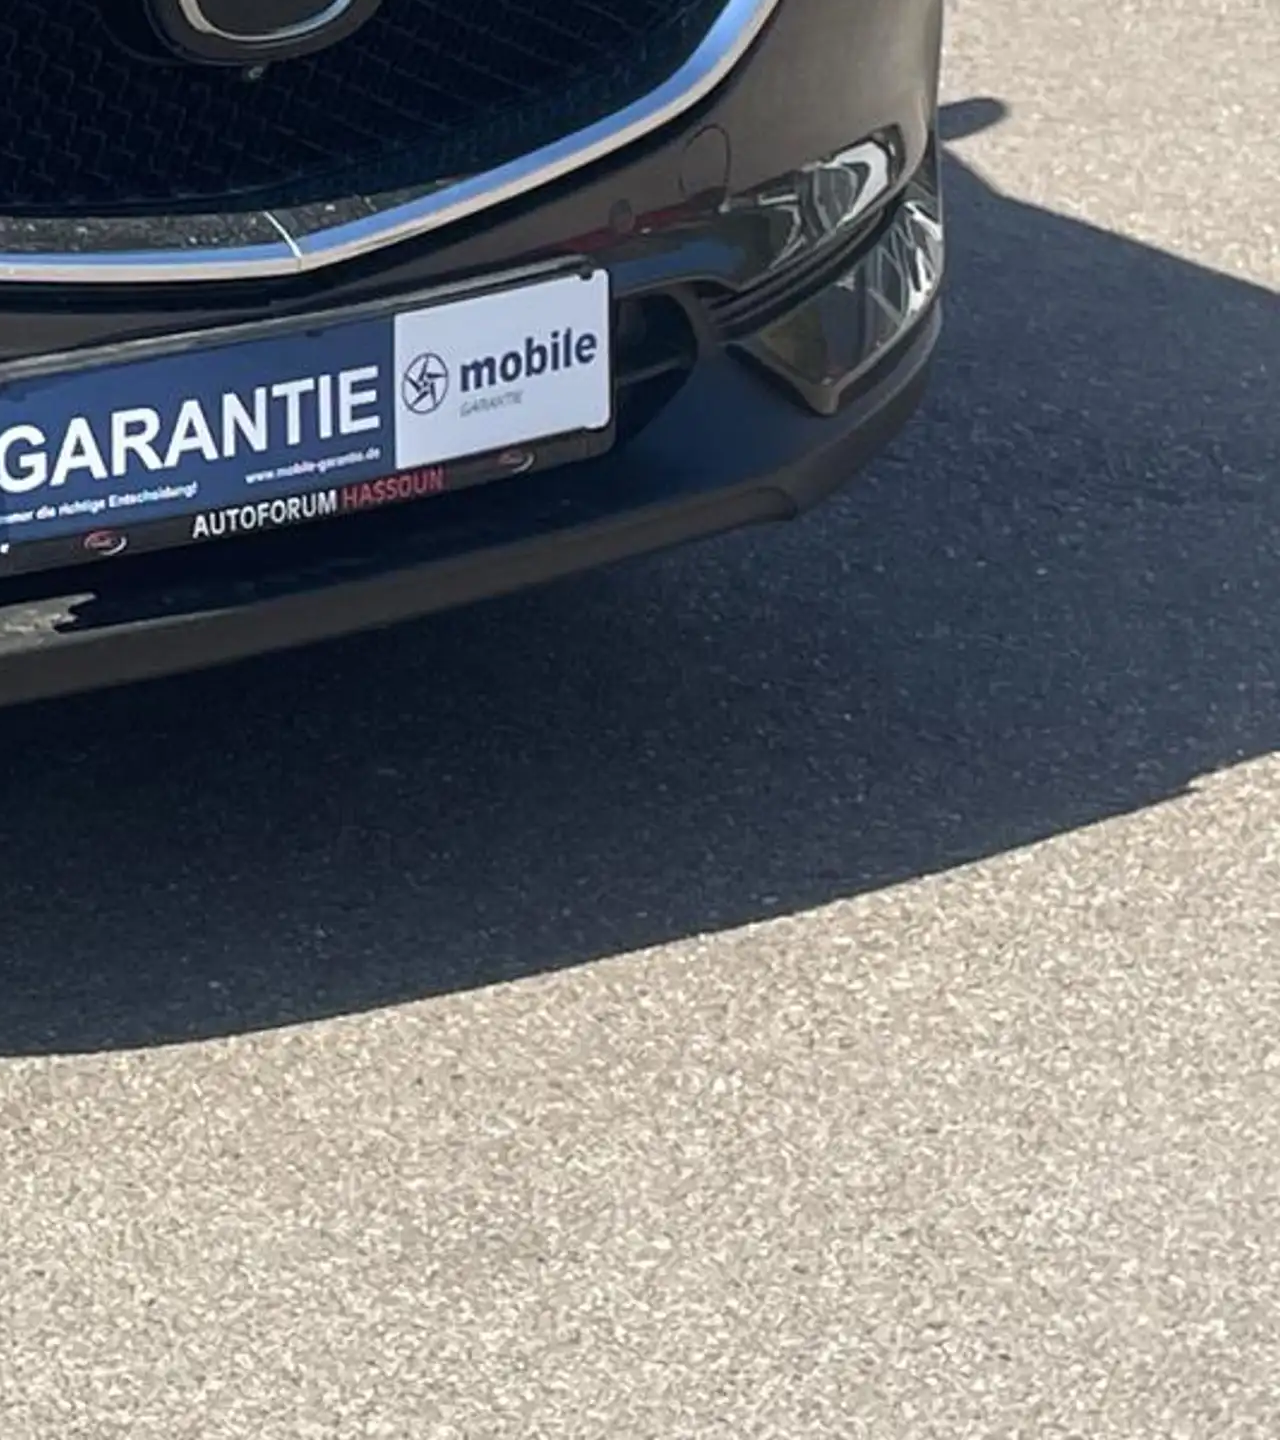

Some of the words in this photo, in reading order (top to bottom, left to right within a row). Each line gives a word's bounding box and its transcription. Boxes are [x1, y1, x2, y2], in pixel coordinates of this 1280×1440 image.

[459, 327, 597, 392] mobile
[245, 447, 381, 484] www.mobile-garantie.de
[192, 489, 337, 539] AUTOFORUM
[343, 468, 445, 509] HASSOUN
